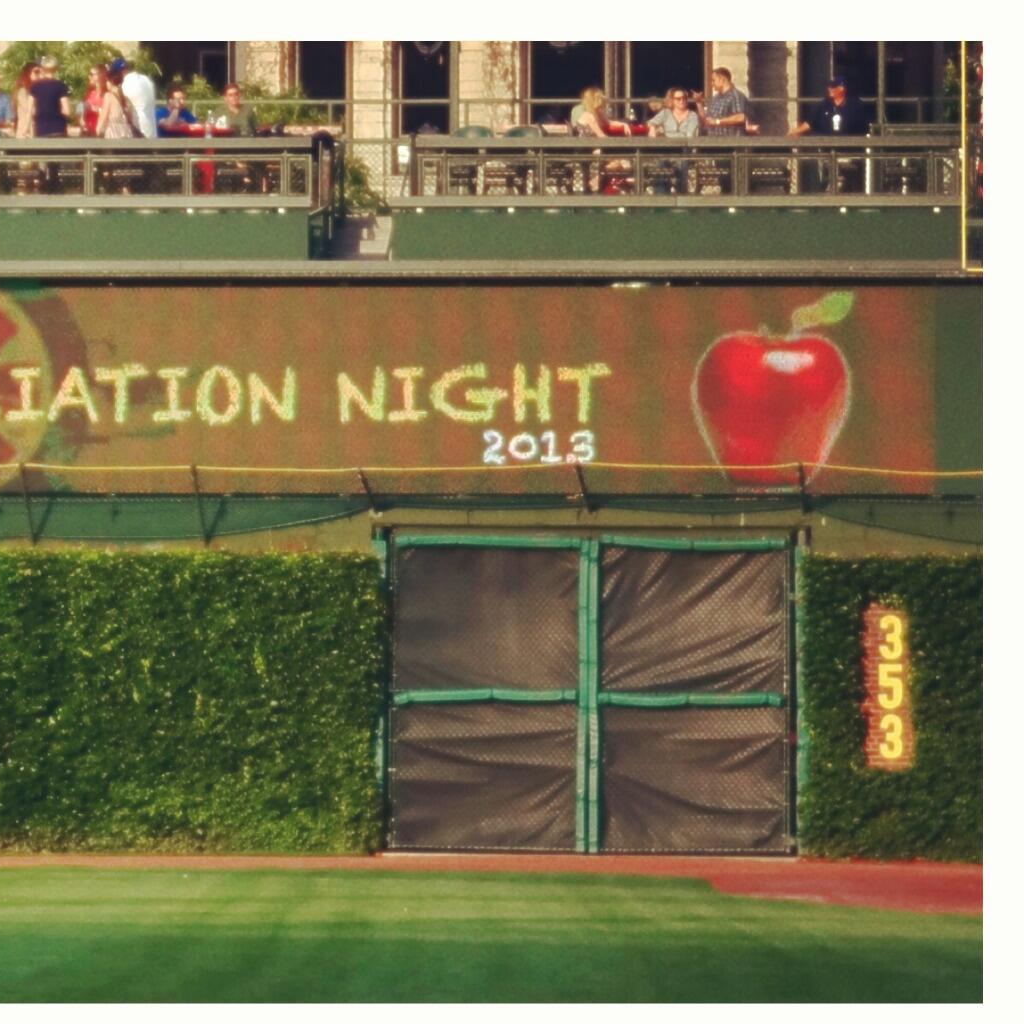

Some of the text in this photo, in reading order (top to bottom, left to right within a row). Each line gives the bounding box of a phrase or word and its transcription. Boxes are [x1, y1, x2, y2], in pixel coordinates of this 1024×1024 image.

[337, 361, 612, 425] NIGHT
[482, 429, 596, 464] 2013
[878, 614, 903, 760] 353
